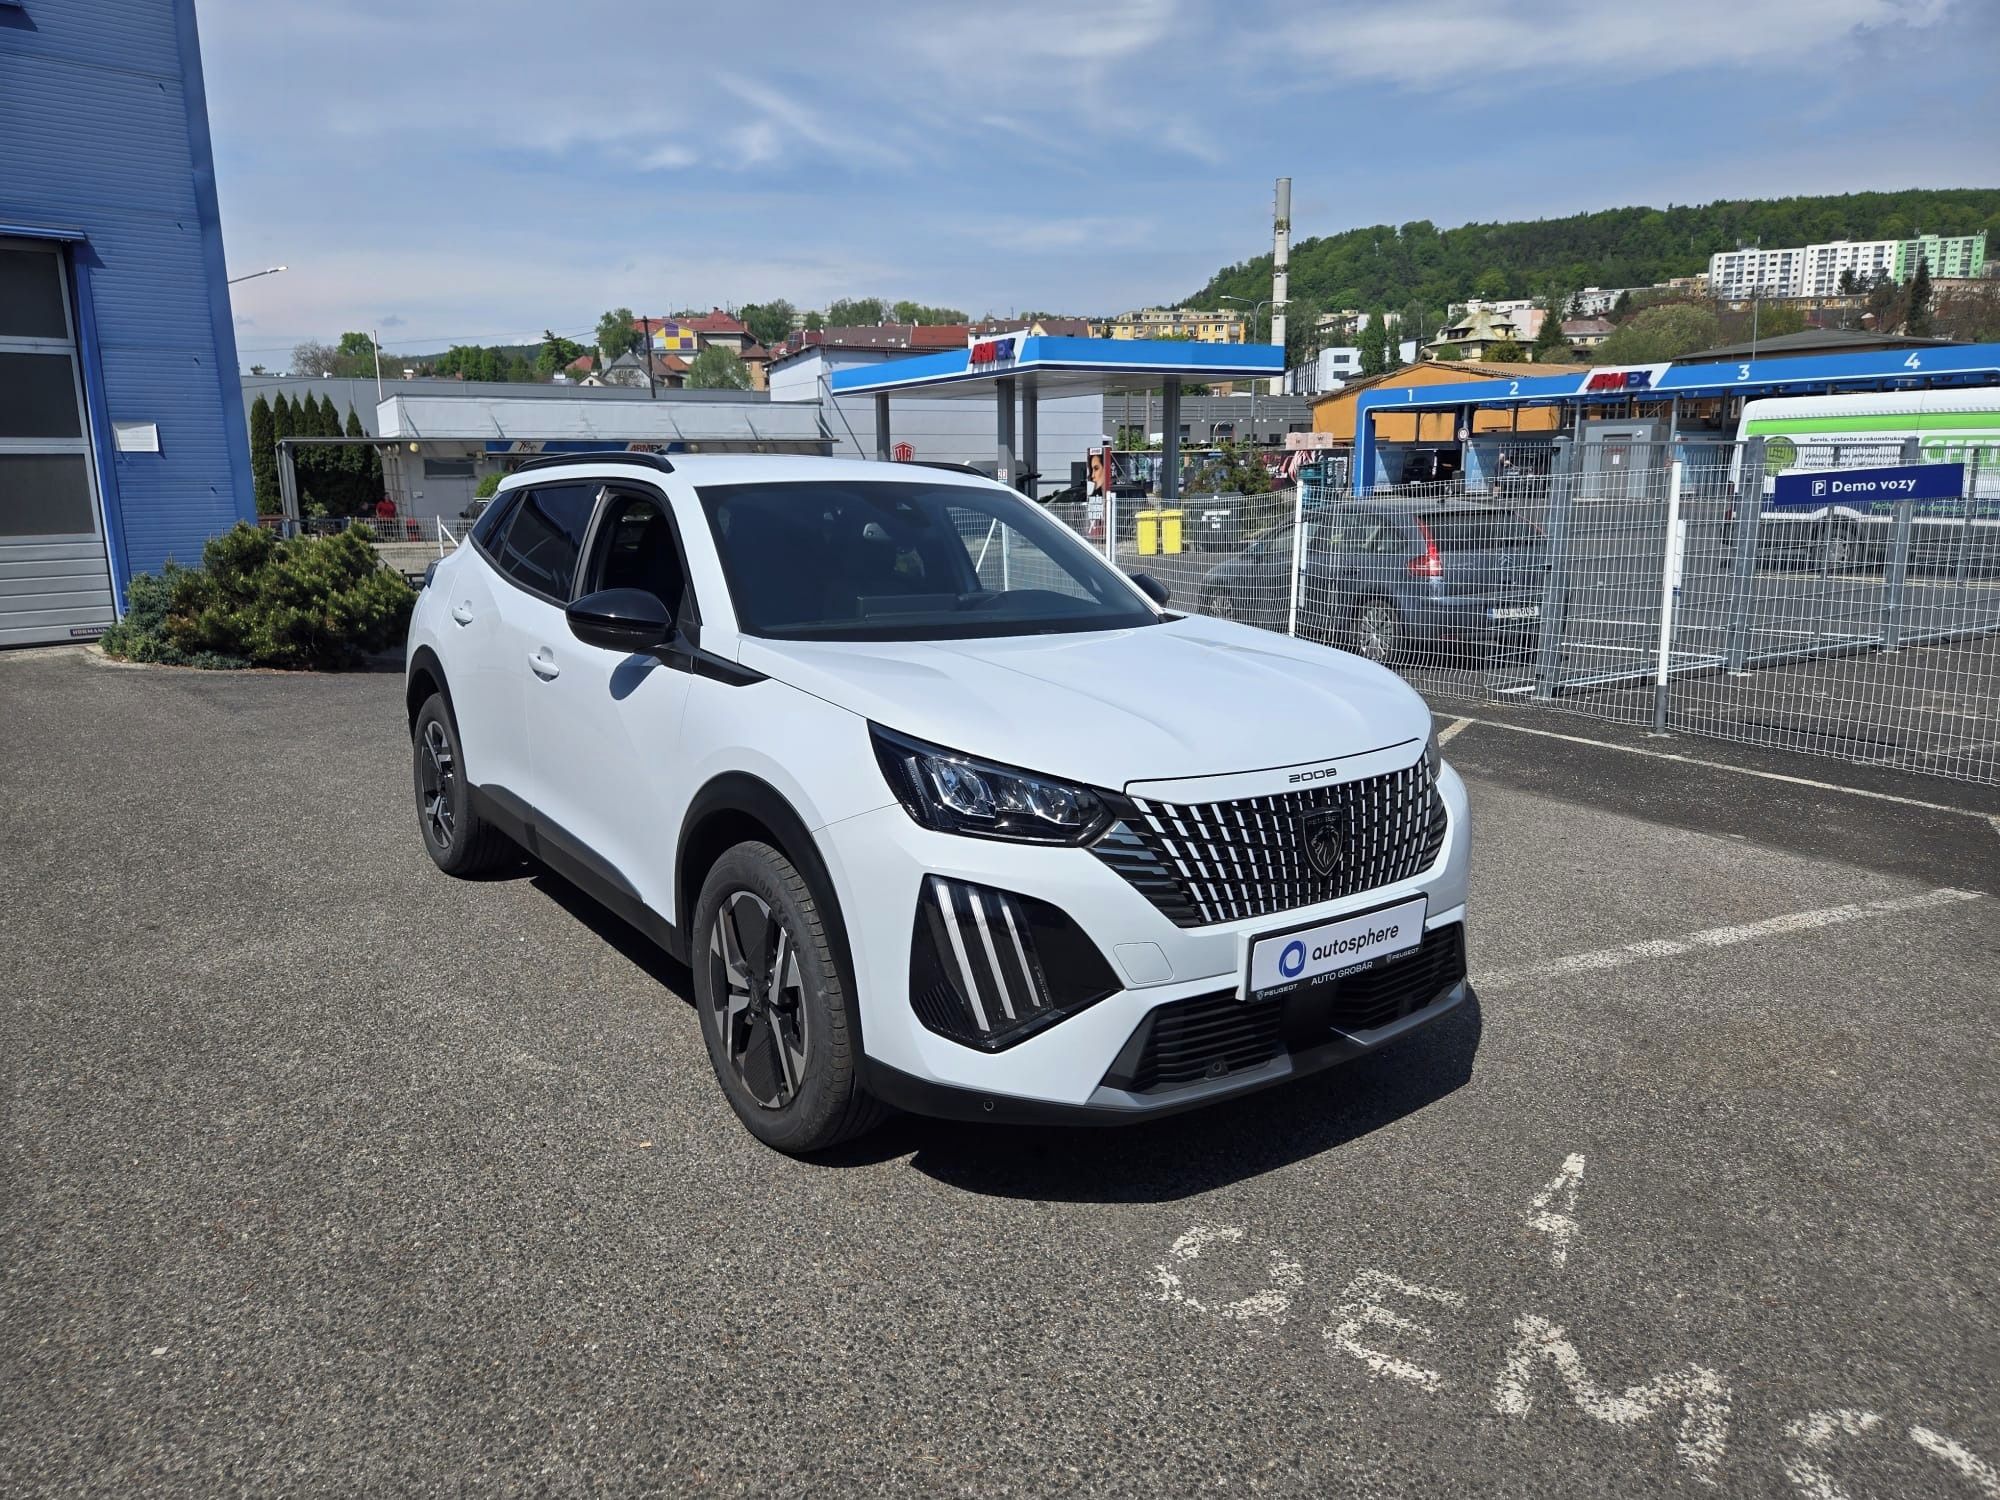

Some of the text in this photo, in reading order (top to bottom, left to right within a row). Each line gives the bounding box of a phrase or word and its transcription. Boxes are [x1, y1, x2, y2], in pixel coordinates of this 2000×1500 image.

[970, 338, 1016, 363] ARMEX
[1904, 352, 1920, 369] 4
[1737, 364, 1750, 380] 3
[1586, 370, 1653, 391] ARMEX
[1407, 389, 1413, 401] 1
[1509, 382, 1519, 395] 2
[1815, 480, 1916, 494] P Demo vozy
[1289, 768, 1337, 783] 2008
[1312, 925, 1399, 960] autosphere
[1391, 947, 1419, 960] PEUGEOT
[1311, 960, 1373, 986] AUTO GROBÁR
[1264, 983, 1298, 997] PEUGEOT
